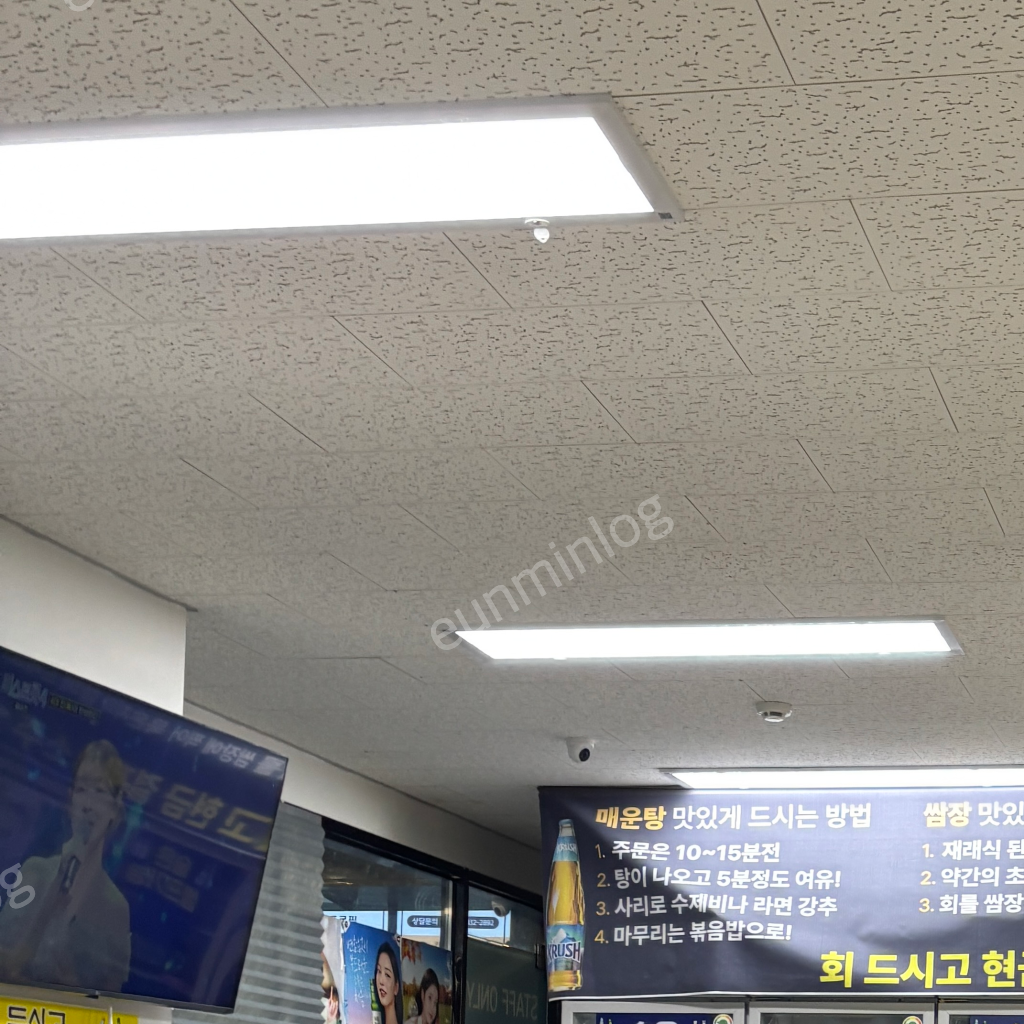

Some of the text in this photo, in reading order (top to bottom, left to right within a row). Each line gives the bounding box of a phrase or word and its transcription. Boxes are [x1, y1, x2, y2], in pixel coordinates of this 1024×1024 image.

[595, 803, 871, 830] 매운탕 맛있게 드시는 방법
[923, 801, 971, 827] 쌈장
[595, 840, 780, 863] 1. 주문은 10~15분전
[921, 843, 934, 859] 1.
[942, 838, 1000, 861] 재래식
[596, 867, 841, 889] 2. 탕이 나오고 5분정도 여유!
[920, 870, 936, 886] 2.
[941, 865, 999, 888] 약간의
[596, 894, 838, 917] 3. 사리로 수제비나 라면 강추
[918, 898, 934, 913] 3.
[939, 893, 979, 914] 회를
[594, 920, 793, 946] 4. 마무리는 볶음밥으로!
[547, 941, 581, 963] KRUSH
[820, 951, 854, 988] 회
[863, 951, 972, 988] 드시고
